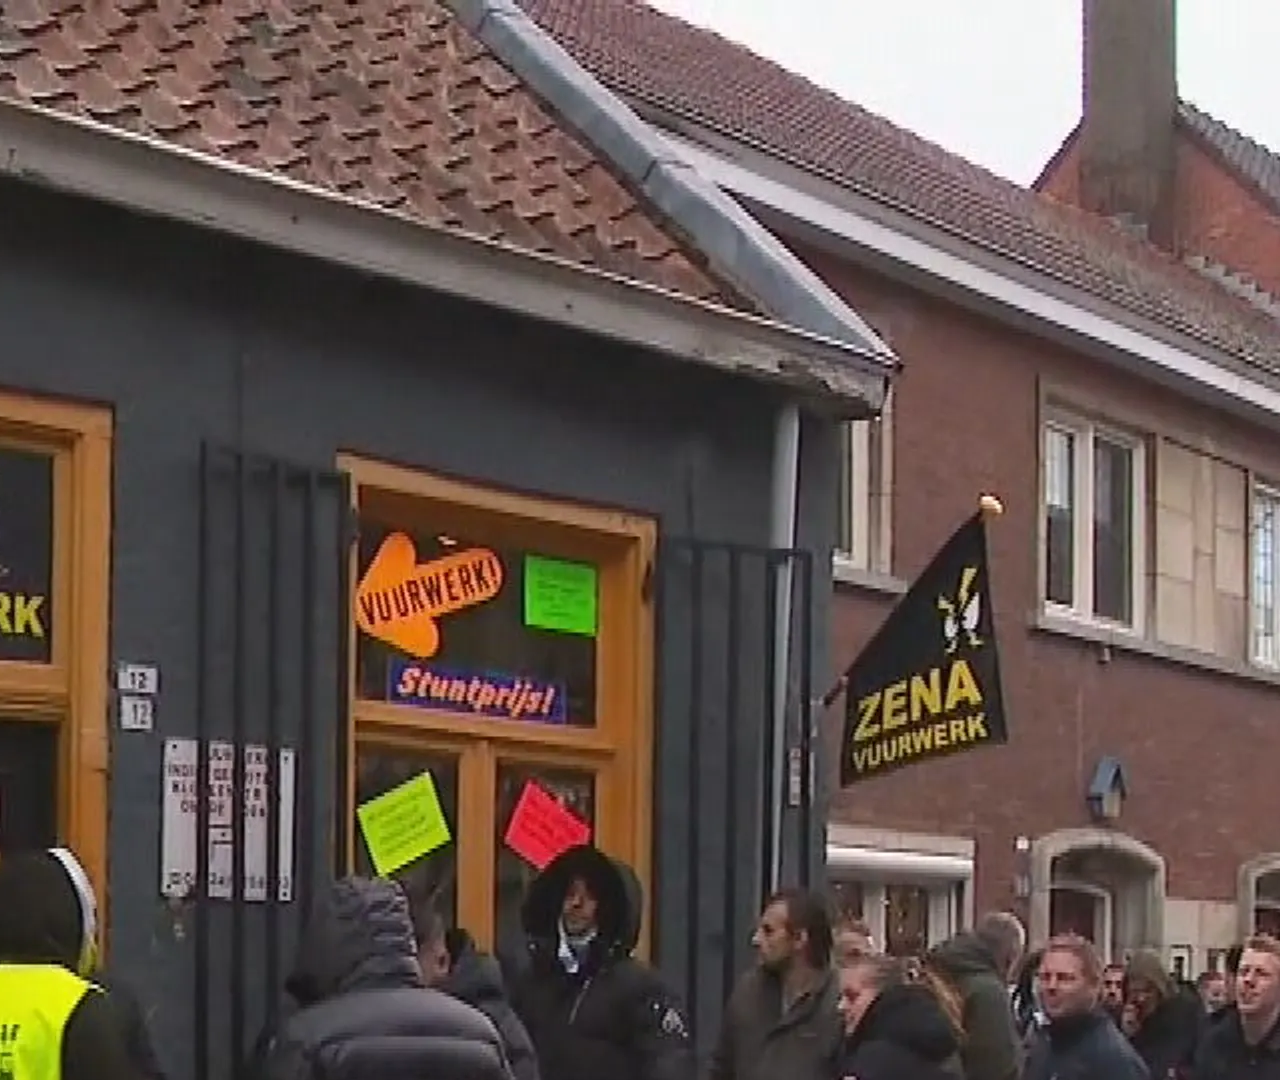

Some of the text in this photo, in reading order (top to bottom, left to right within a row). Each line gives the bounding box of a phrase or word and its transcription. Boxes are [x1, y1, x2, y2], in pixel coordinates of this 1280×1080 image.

[359, 558, 500, 626] VUURWERK!
[129, 672, 148, 690] 12
[397, 667, 556, 718] Stuntprijs!
[853, 660, 984, 742] ZENA
[853, 712, 989, 773] VUURWERK
